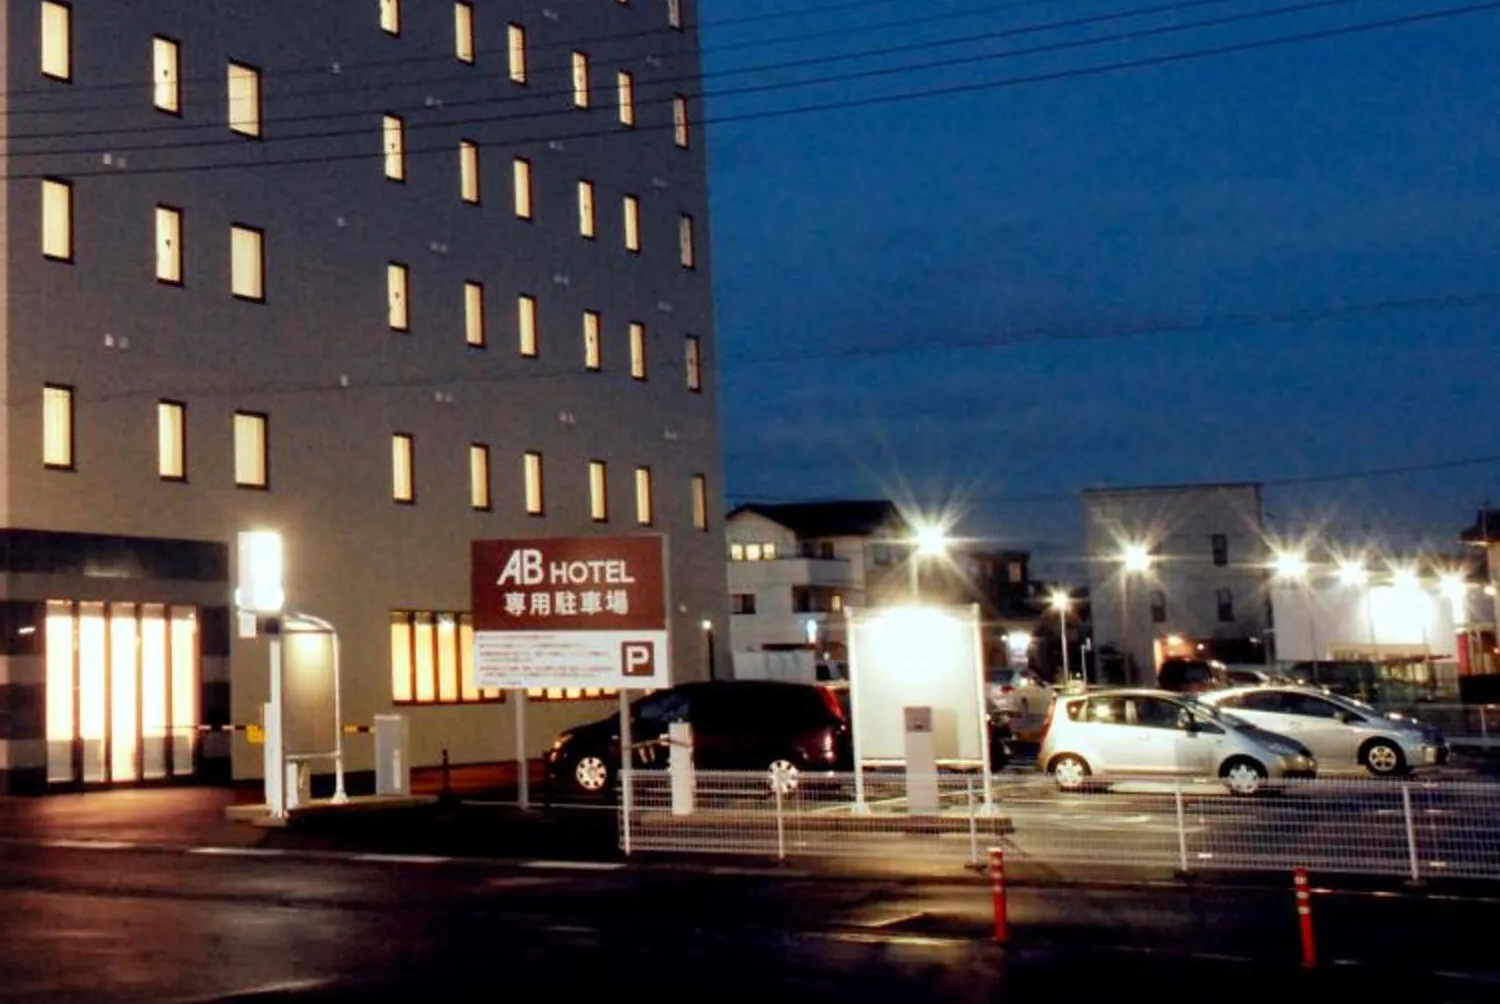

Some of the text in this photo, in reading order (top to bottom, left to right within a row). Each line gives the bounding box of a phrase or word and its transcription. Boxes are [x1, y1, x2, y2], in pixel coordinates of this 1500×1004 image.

[497, 549, 635, 586] AB HOTEL
[504, 590, 629, 616] 専用駐車場
[626, 646, 649, 673] P
